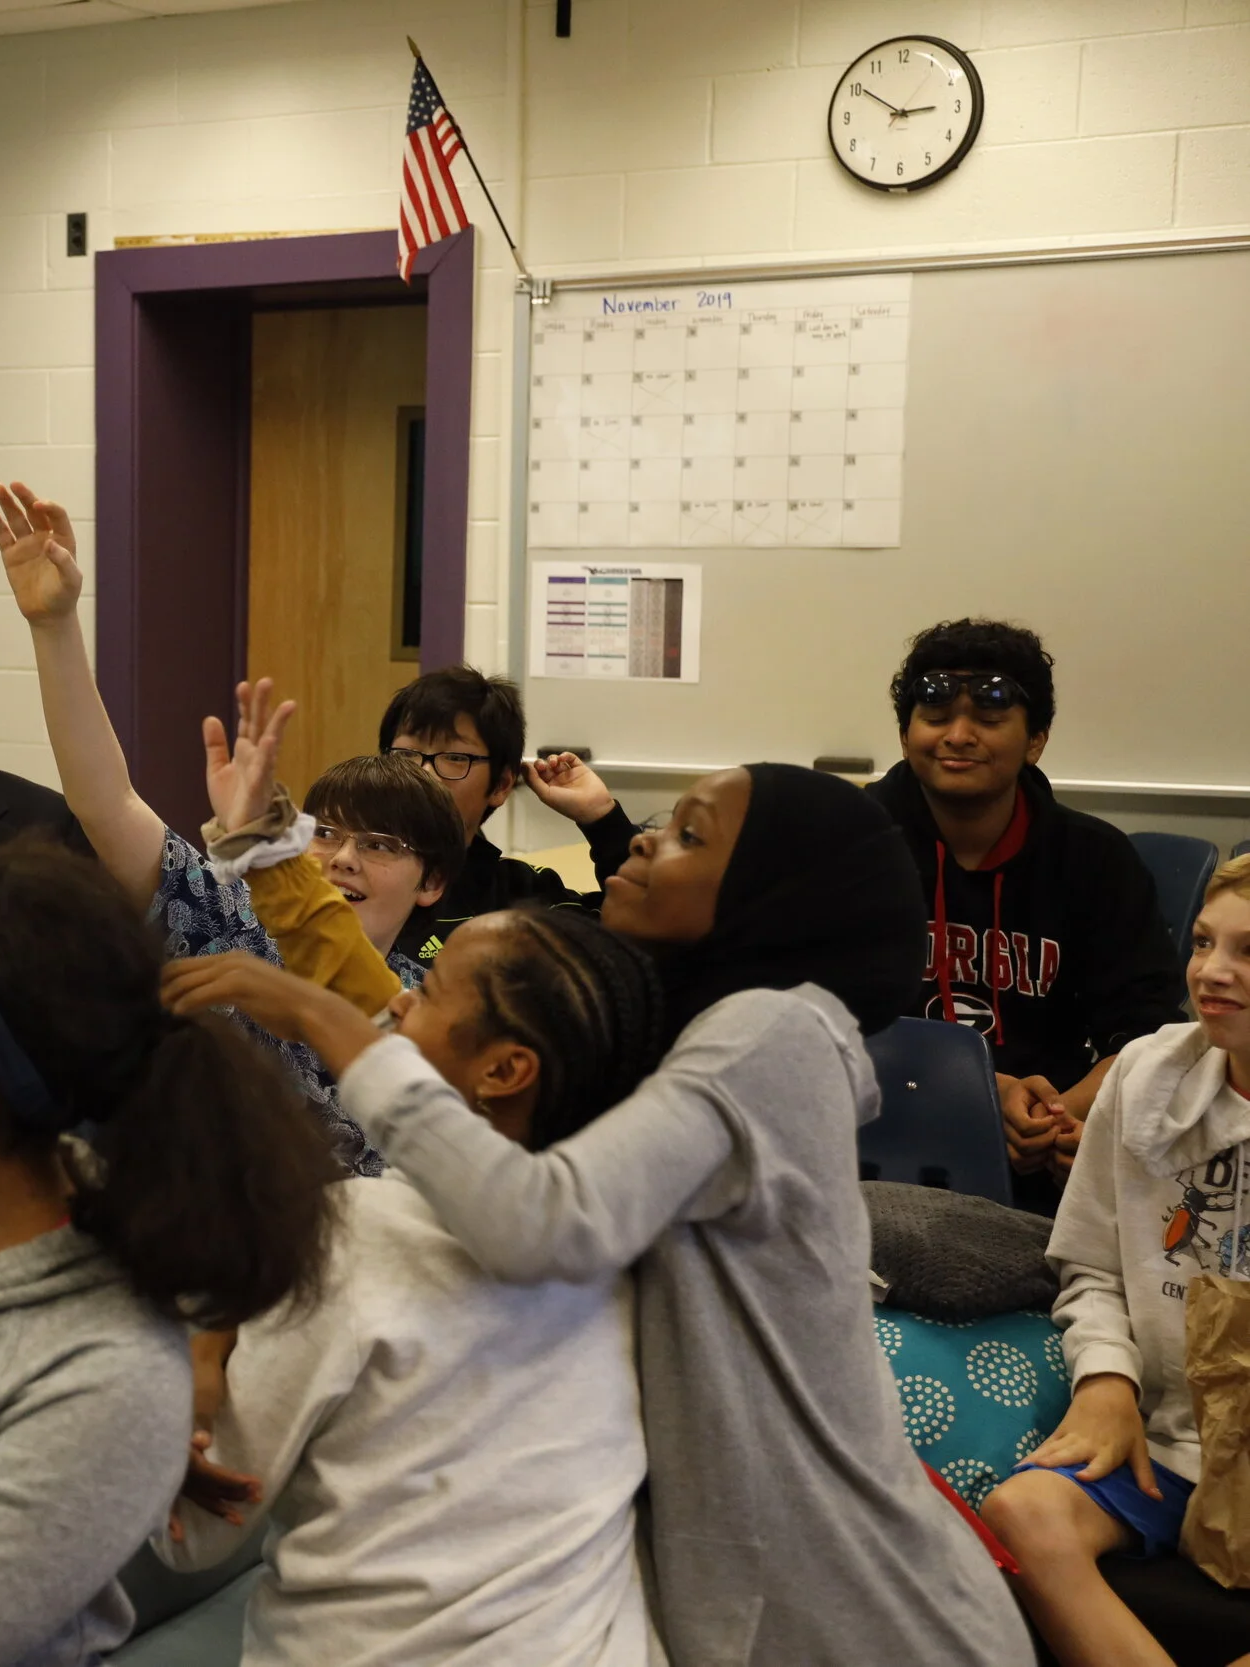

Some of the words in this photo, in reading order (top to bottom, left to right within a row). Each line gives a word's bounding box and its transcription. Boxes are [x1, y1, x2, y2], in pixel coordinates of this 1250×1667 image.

[898, 49, 910, 64] 12
[870, 60, 882, 74] 11
[850, 82, 862, 97] 10
[954, 99, 961, 114] 3
[843, 111, 851, 125] 9
[924, 152, 932, 166] 5
[896, 162, 904, 176] 6
[603, 294, 679, 315] November
[696, 291, 732, 309] 2019
[418, 949, 439, 959] adid
[1162, 1281, 1188, 1300] CEN
